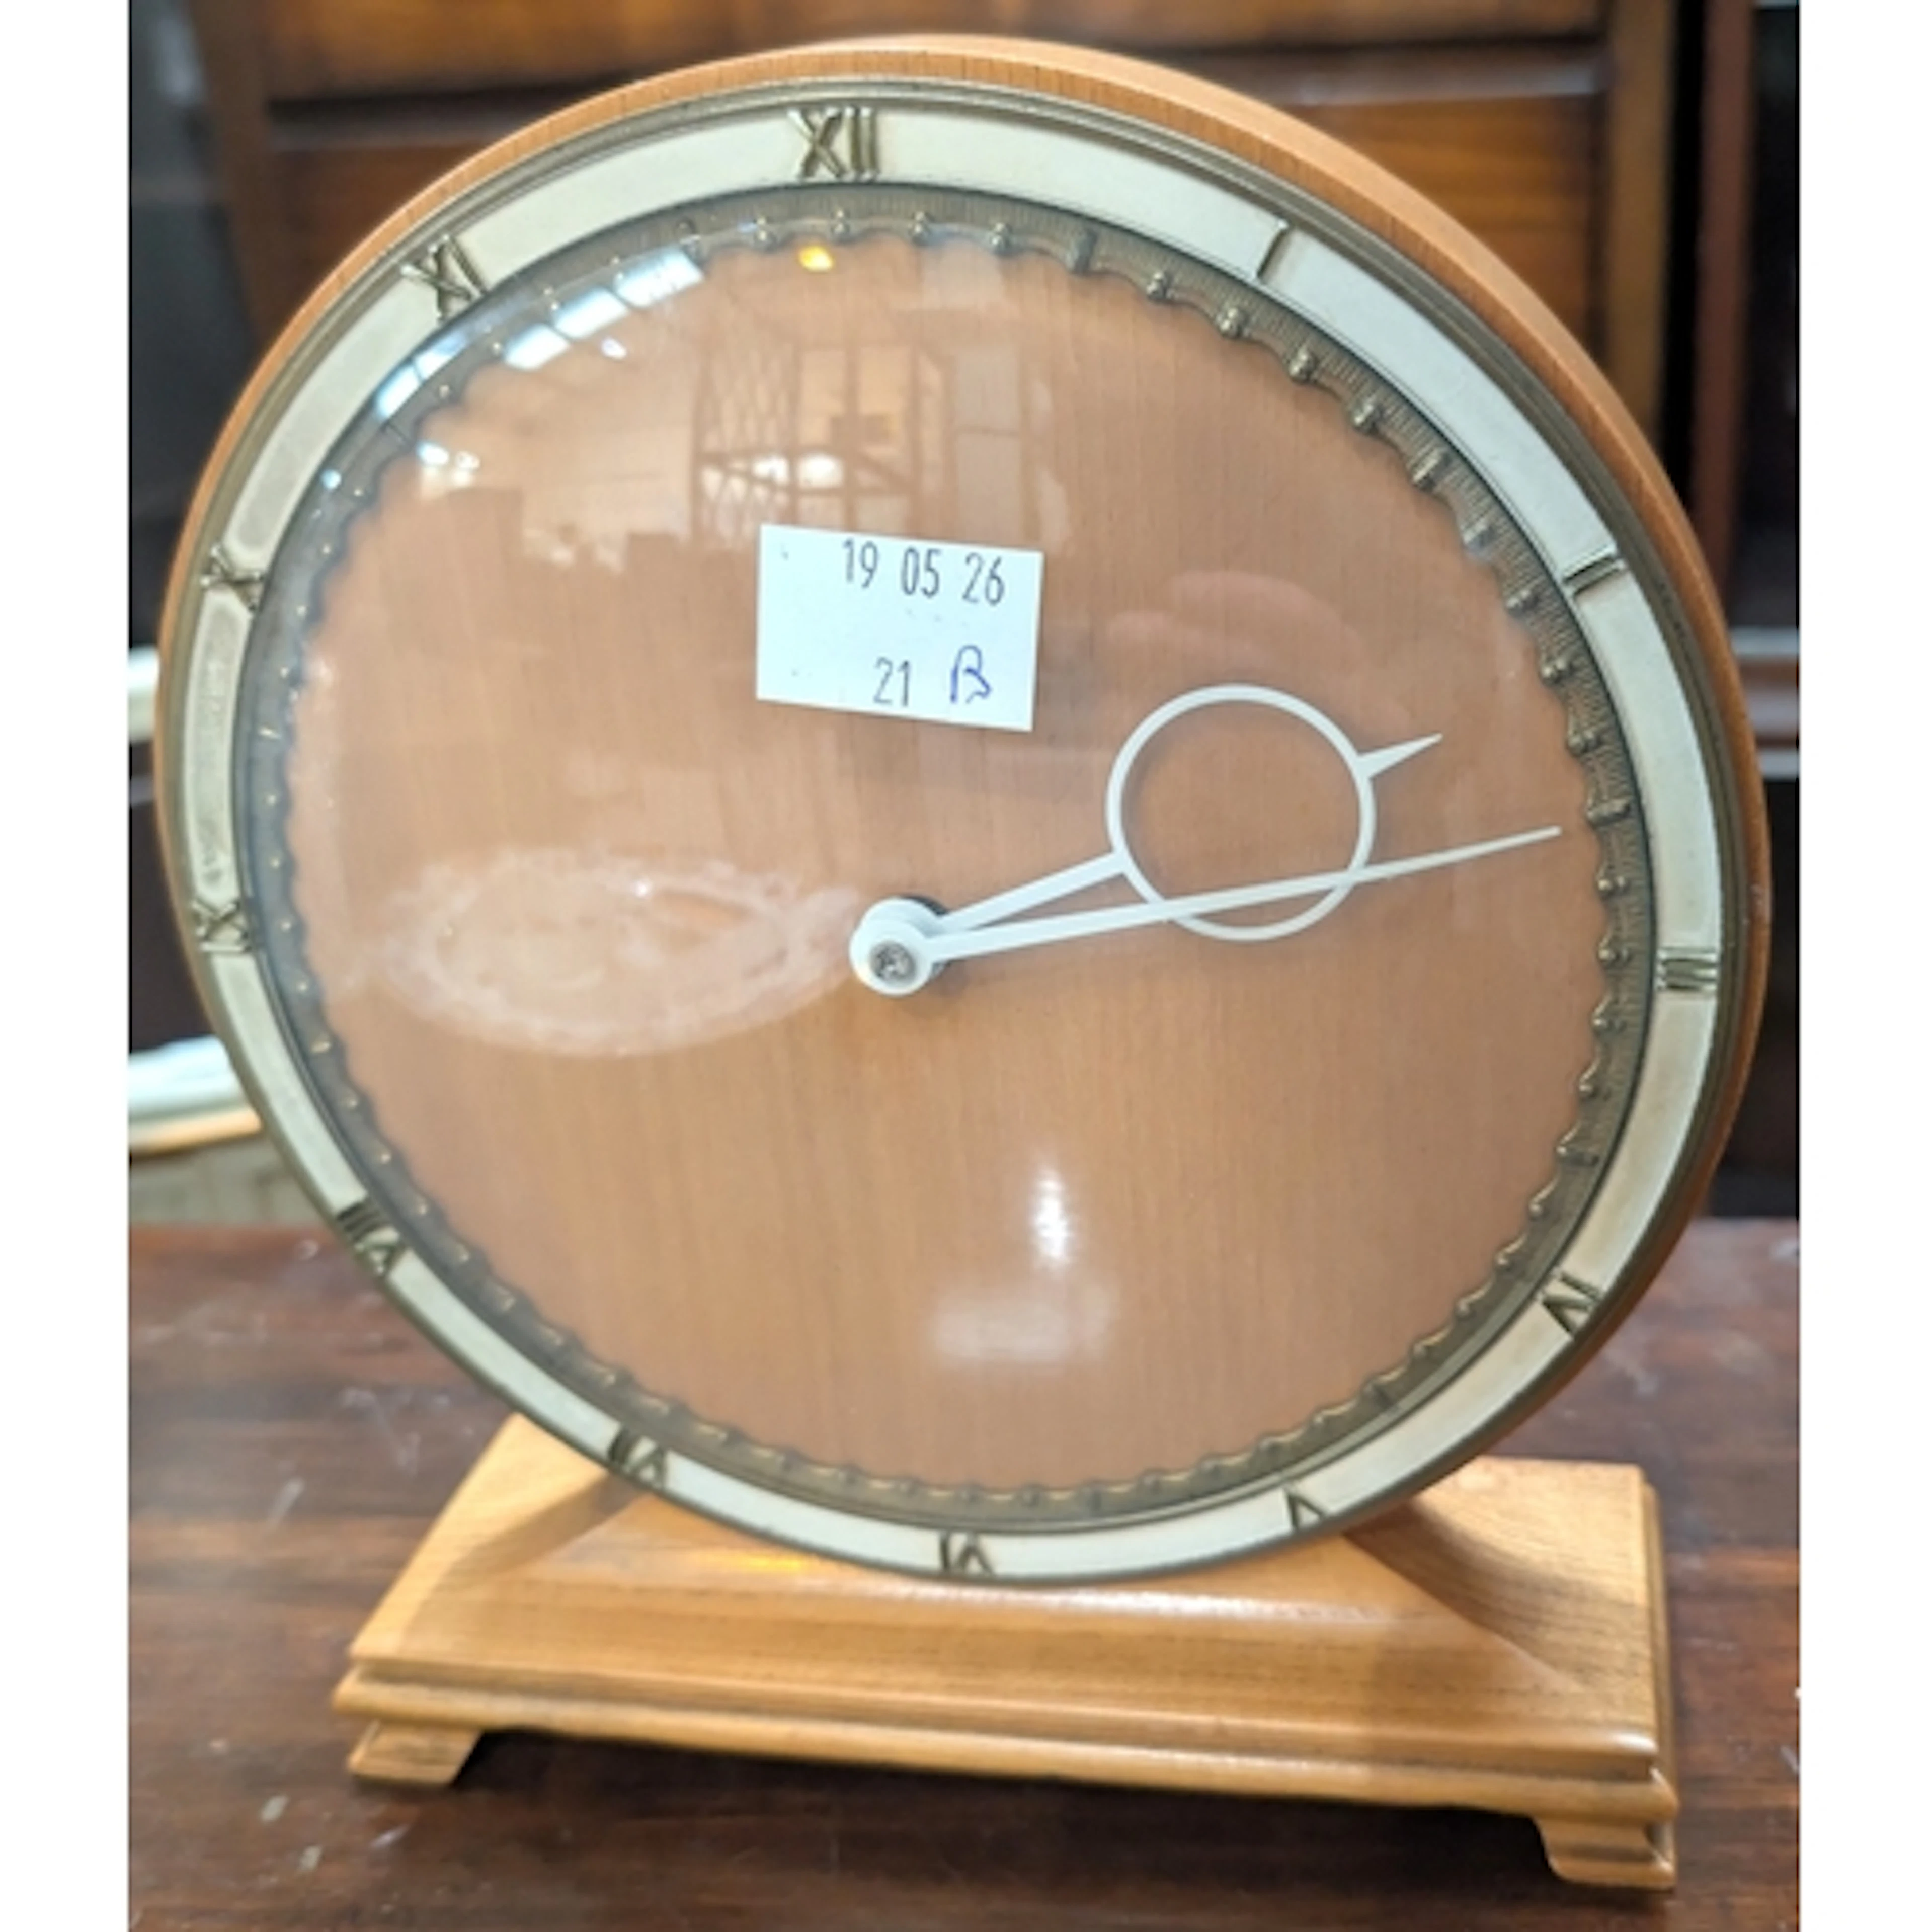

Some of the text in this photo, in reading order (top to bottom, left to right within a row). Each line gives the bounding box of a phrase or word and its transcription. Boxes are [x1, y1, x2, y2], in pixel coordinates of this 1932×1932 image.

[787, 105, 879, 181] XII
[401, 232, 488, 324] XI
[1254, 220, 1292, 285] I
[200, 542, 265, 615] X
[843, 538, 1006, 606] 19 05 26
[1561, 548, 1627, 599] II
[873, 656, 911, 708] 21
[190, 898, 253, 954] IX
[1656, 947, 1719, 993] III
[1538, 1267, 1601, 1336] IV
[1283, 1485, 1327, 1532] V
[938, 1531, 995, 1577] VI
